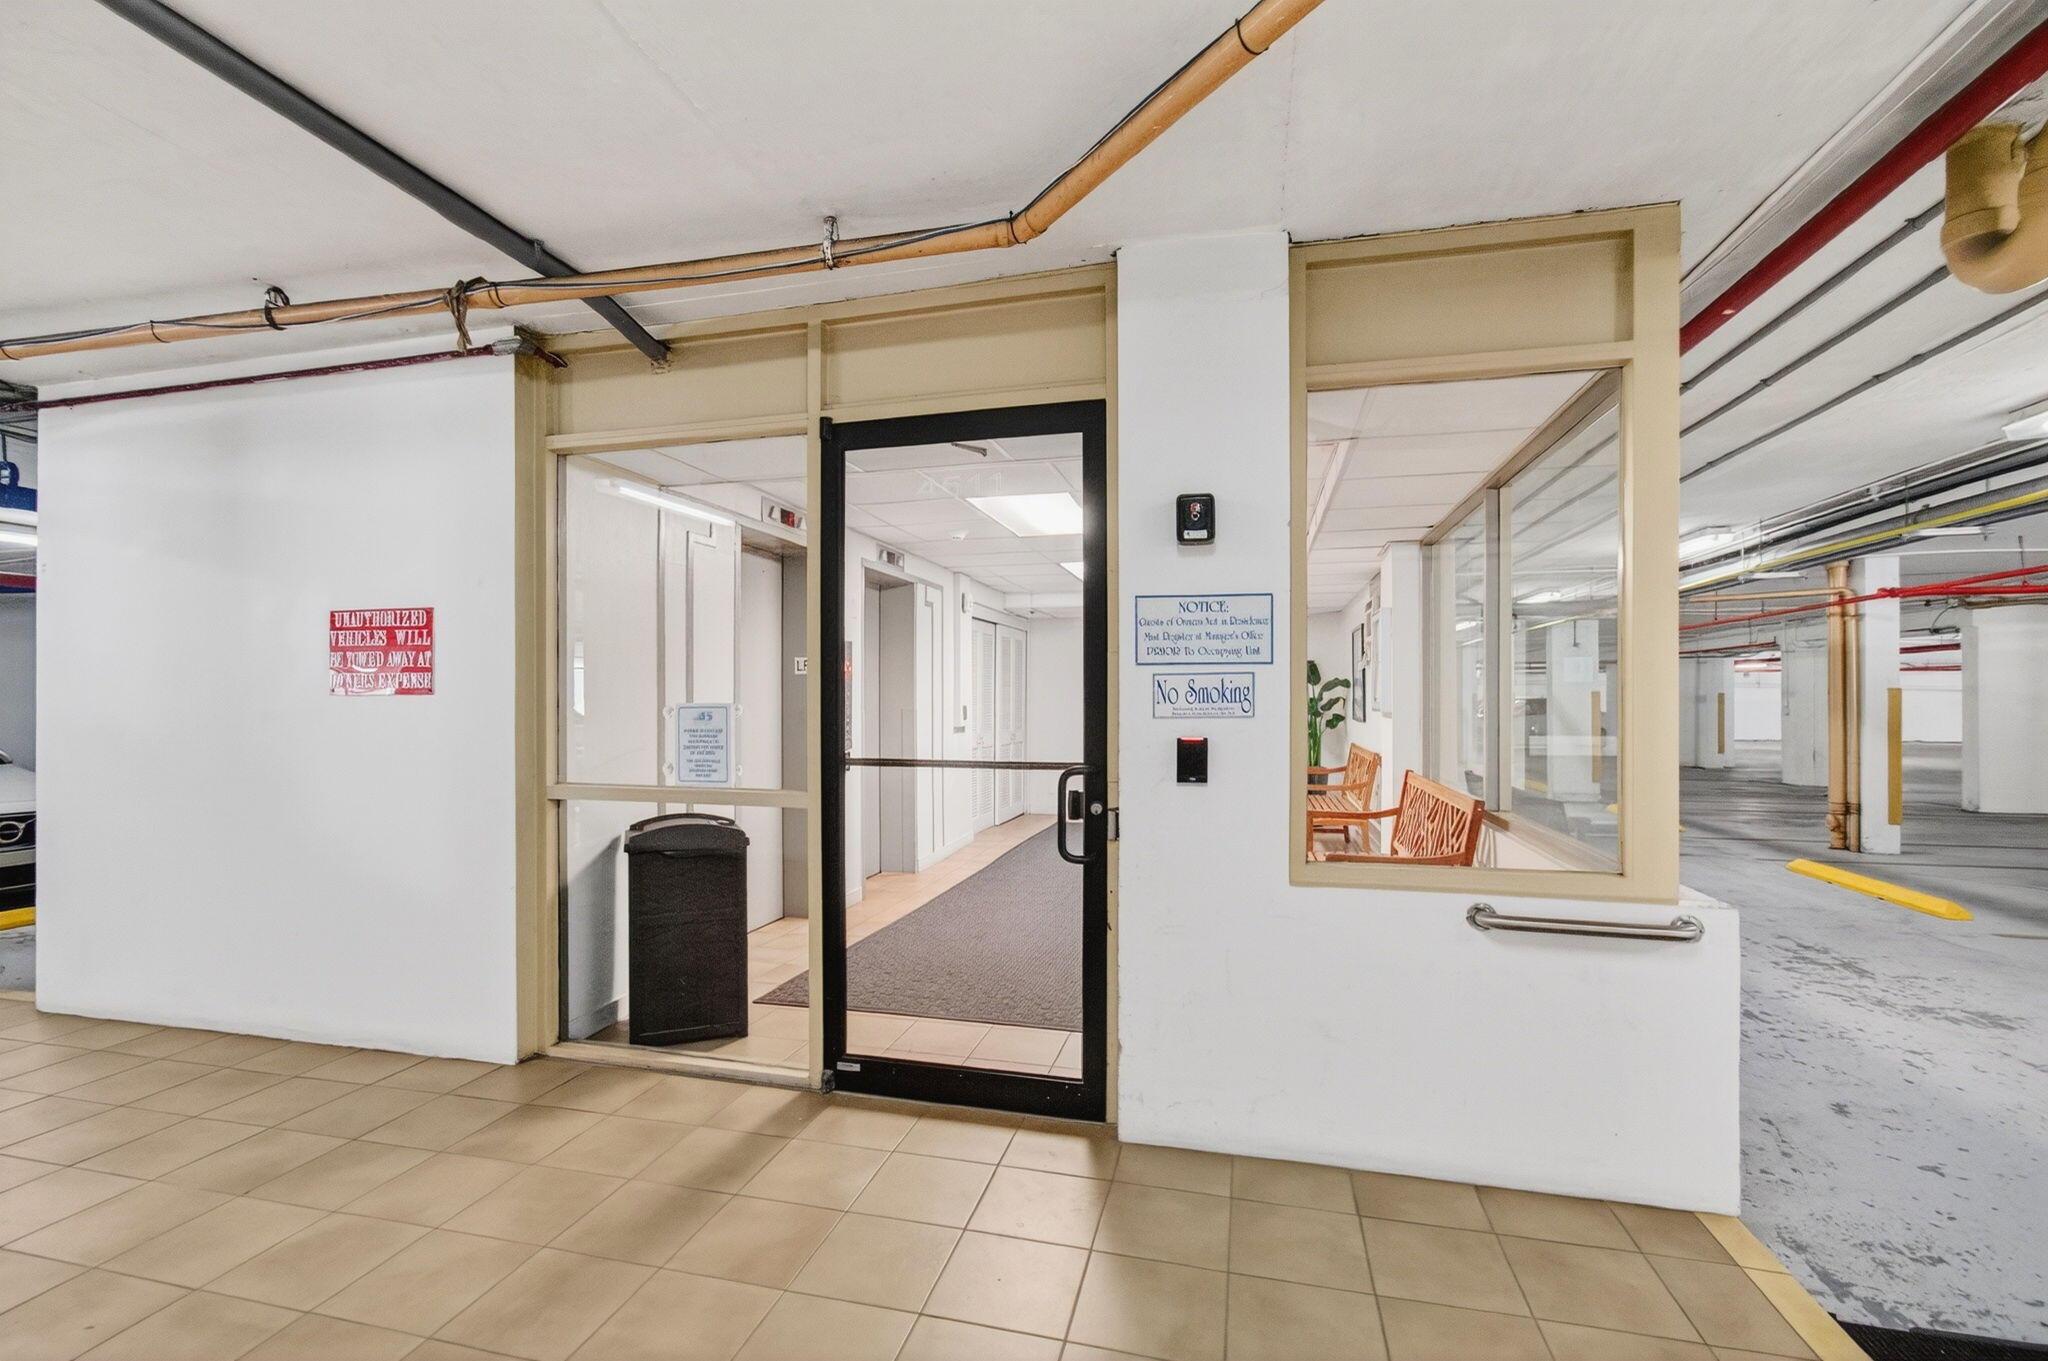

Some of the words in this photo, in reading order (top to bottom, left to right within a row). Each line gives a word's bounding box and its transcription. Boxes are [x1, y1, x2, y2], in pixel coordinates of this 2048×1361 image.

[1178, 600, 1230, 613] NOTICE:
[334, 610, 427, 628] UNAUTHORIZED
[330, 629, 387, 647] VEHICLES
[394, 629, 431, 646] WILL
[345, 651, 384, 667] TOWED
[386, 651, 415, 668] AWAY
[417, 651, 432, 668] AT
[378, 672, 432, 689] EXPENSE
[1156, 679, 1179, 705] No
[1184, 678, 1251, 713] Smoking
